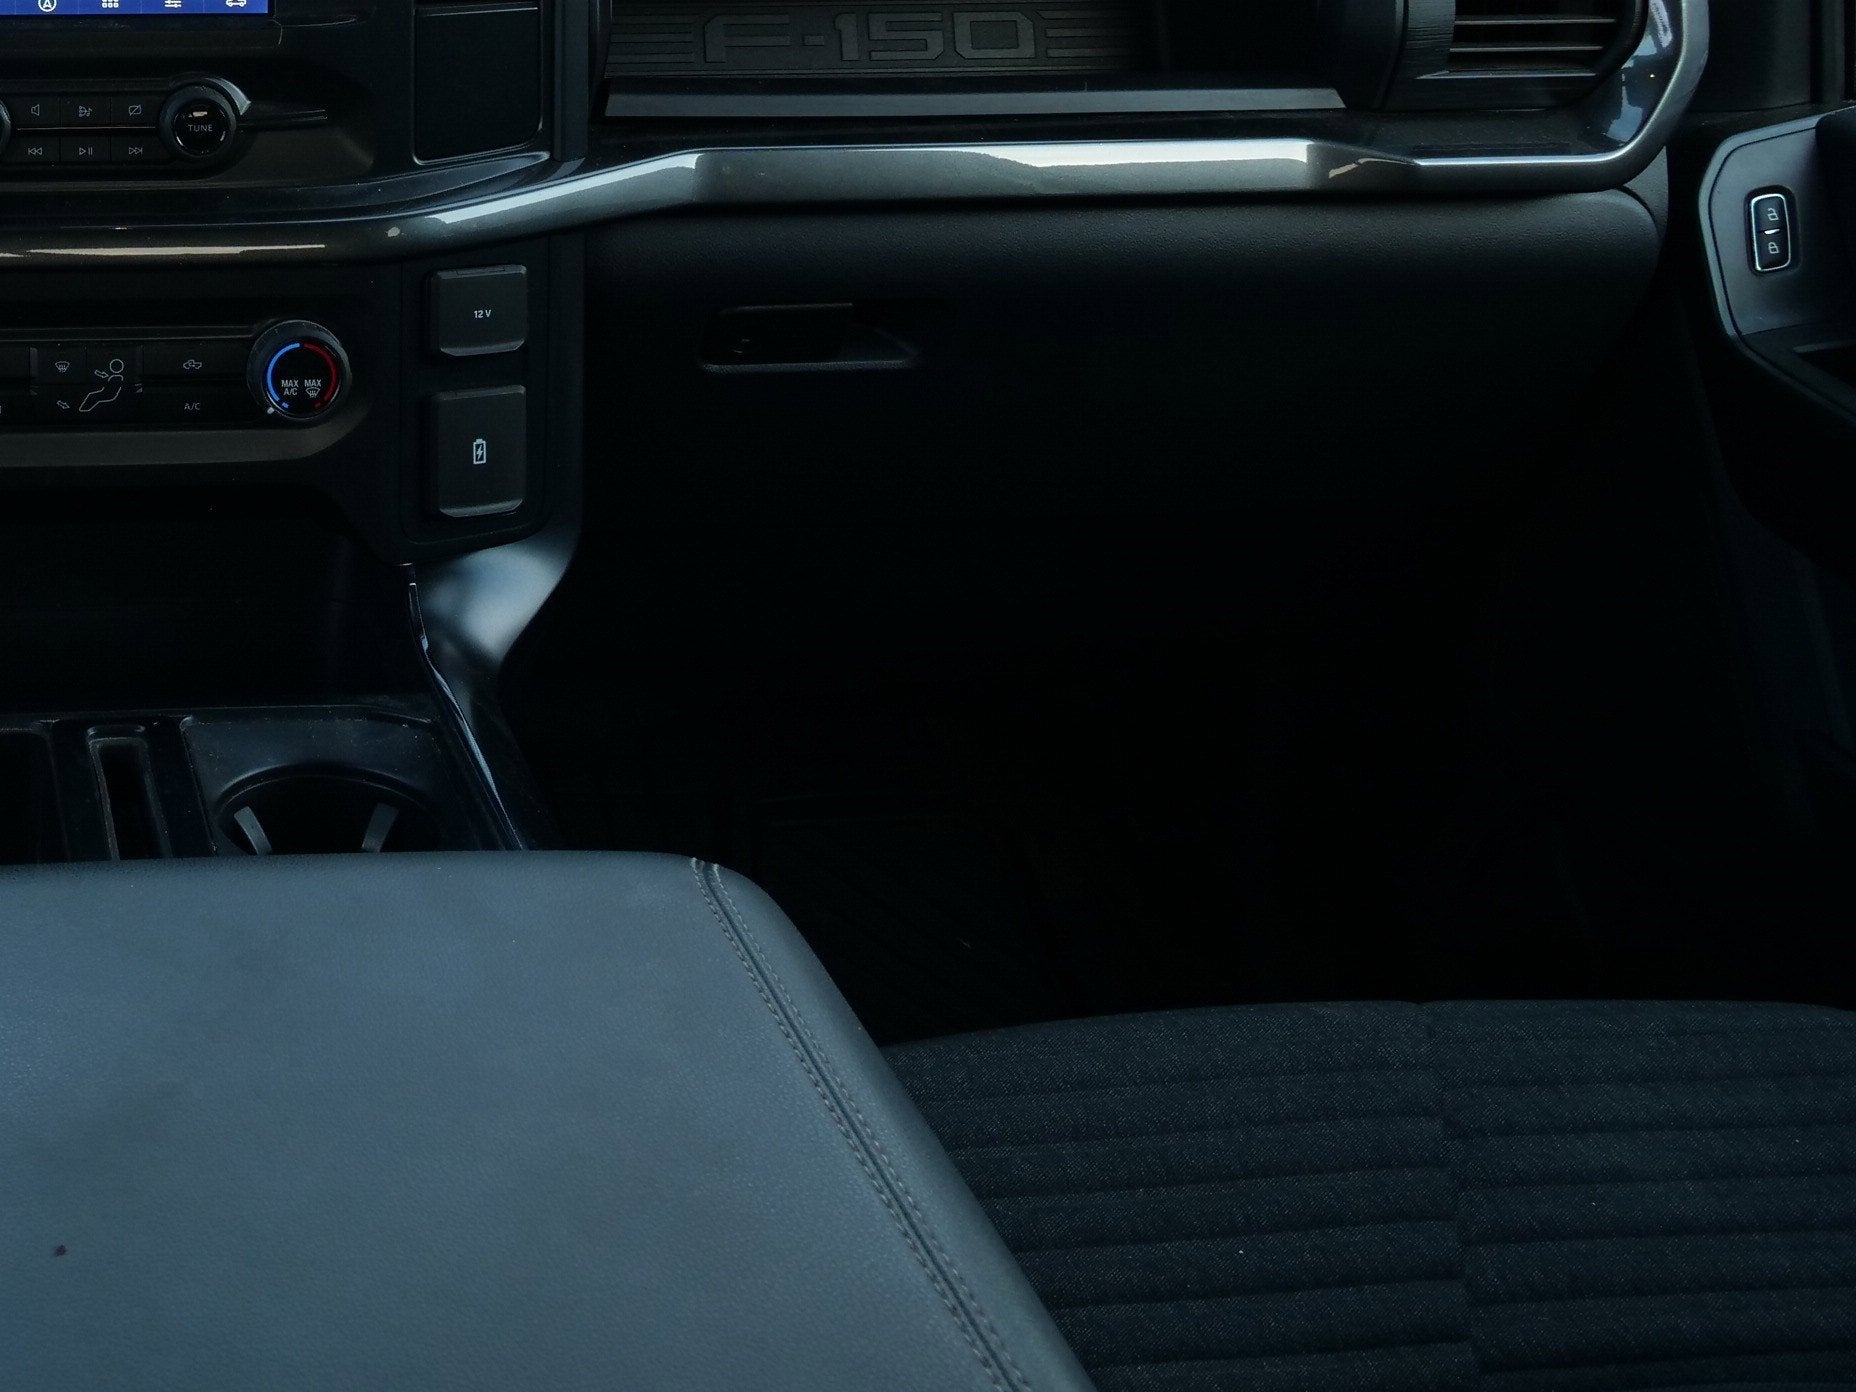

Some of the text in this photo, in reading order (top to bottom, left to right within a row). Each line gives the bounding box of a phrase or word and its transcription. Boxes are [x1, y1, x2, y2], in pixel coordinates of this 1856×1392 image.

[703, 11, 1036, 63] F-150
[188, 124, 213, 133] TUNE
[280, 379, 298, 388] MAX
[303, 379, 322, 388] MAX
[283, 388, 298, 396] A/C
[183, 402, 201, 411] A/C
